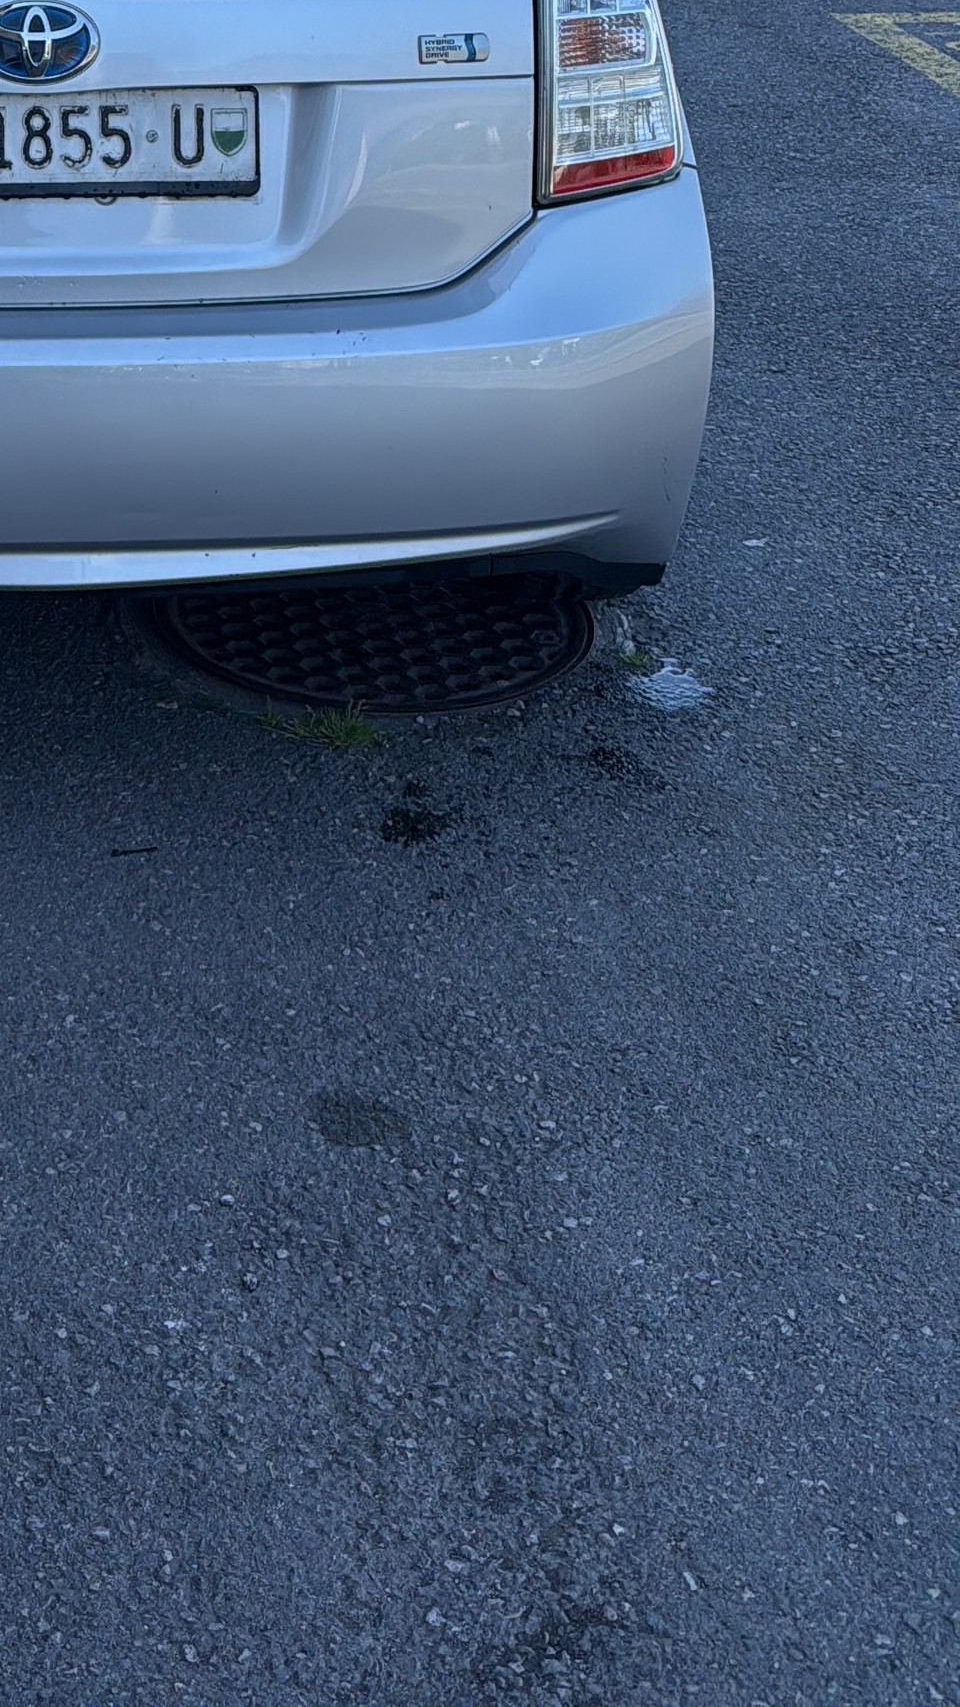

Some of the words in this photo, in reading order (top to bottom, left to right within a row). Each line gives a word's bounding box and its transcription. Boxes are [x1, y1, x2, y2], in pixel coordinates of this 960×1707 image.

[424, 38, 455, 46] HYBRID
[425, 44, 463, 52] SYNERGY
[425, 51, 450, 59] DRIVE
[171, 103, 205, 168] U
